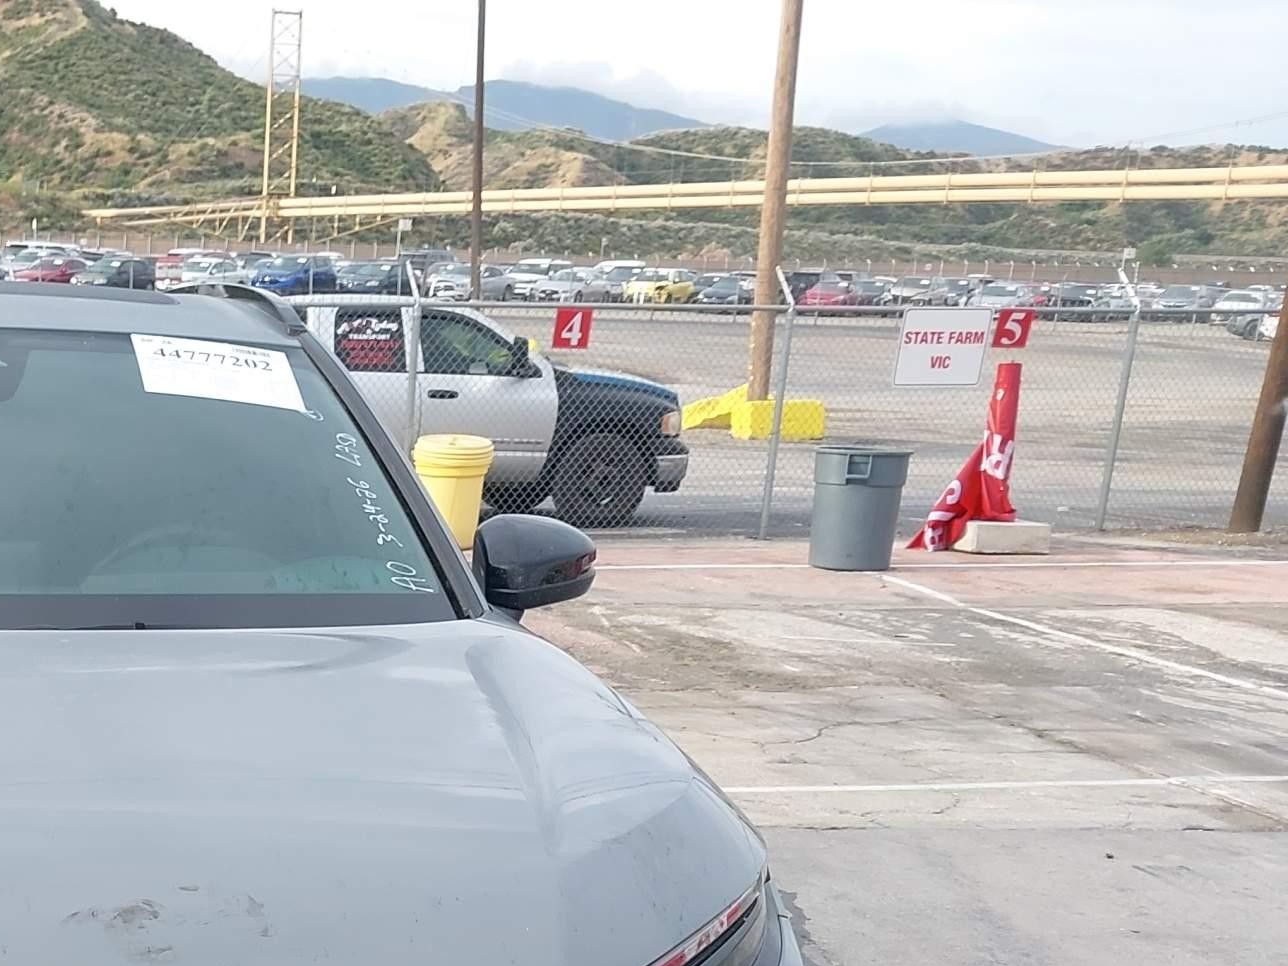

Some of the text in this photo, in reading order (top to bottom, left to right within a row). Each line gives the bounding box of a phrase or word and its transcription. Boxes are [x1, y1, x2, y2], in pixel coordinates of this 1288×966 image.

[560, 311, 582, 345] 4
[903, 331, 985, 345] STATE FARM
[1000, 312, 1026, 344] 5
[153, 347, 273, 372] 44777202
[929, 356, 952, 369] VIC
[346, 476, 404, 548] 3-24-26
